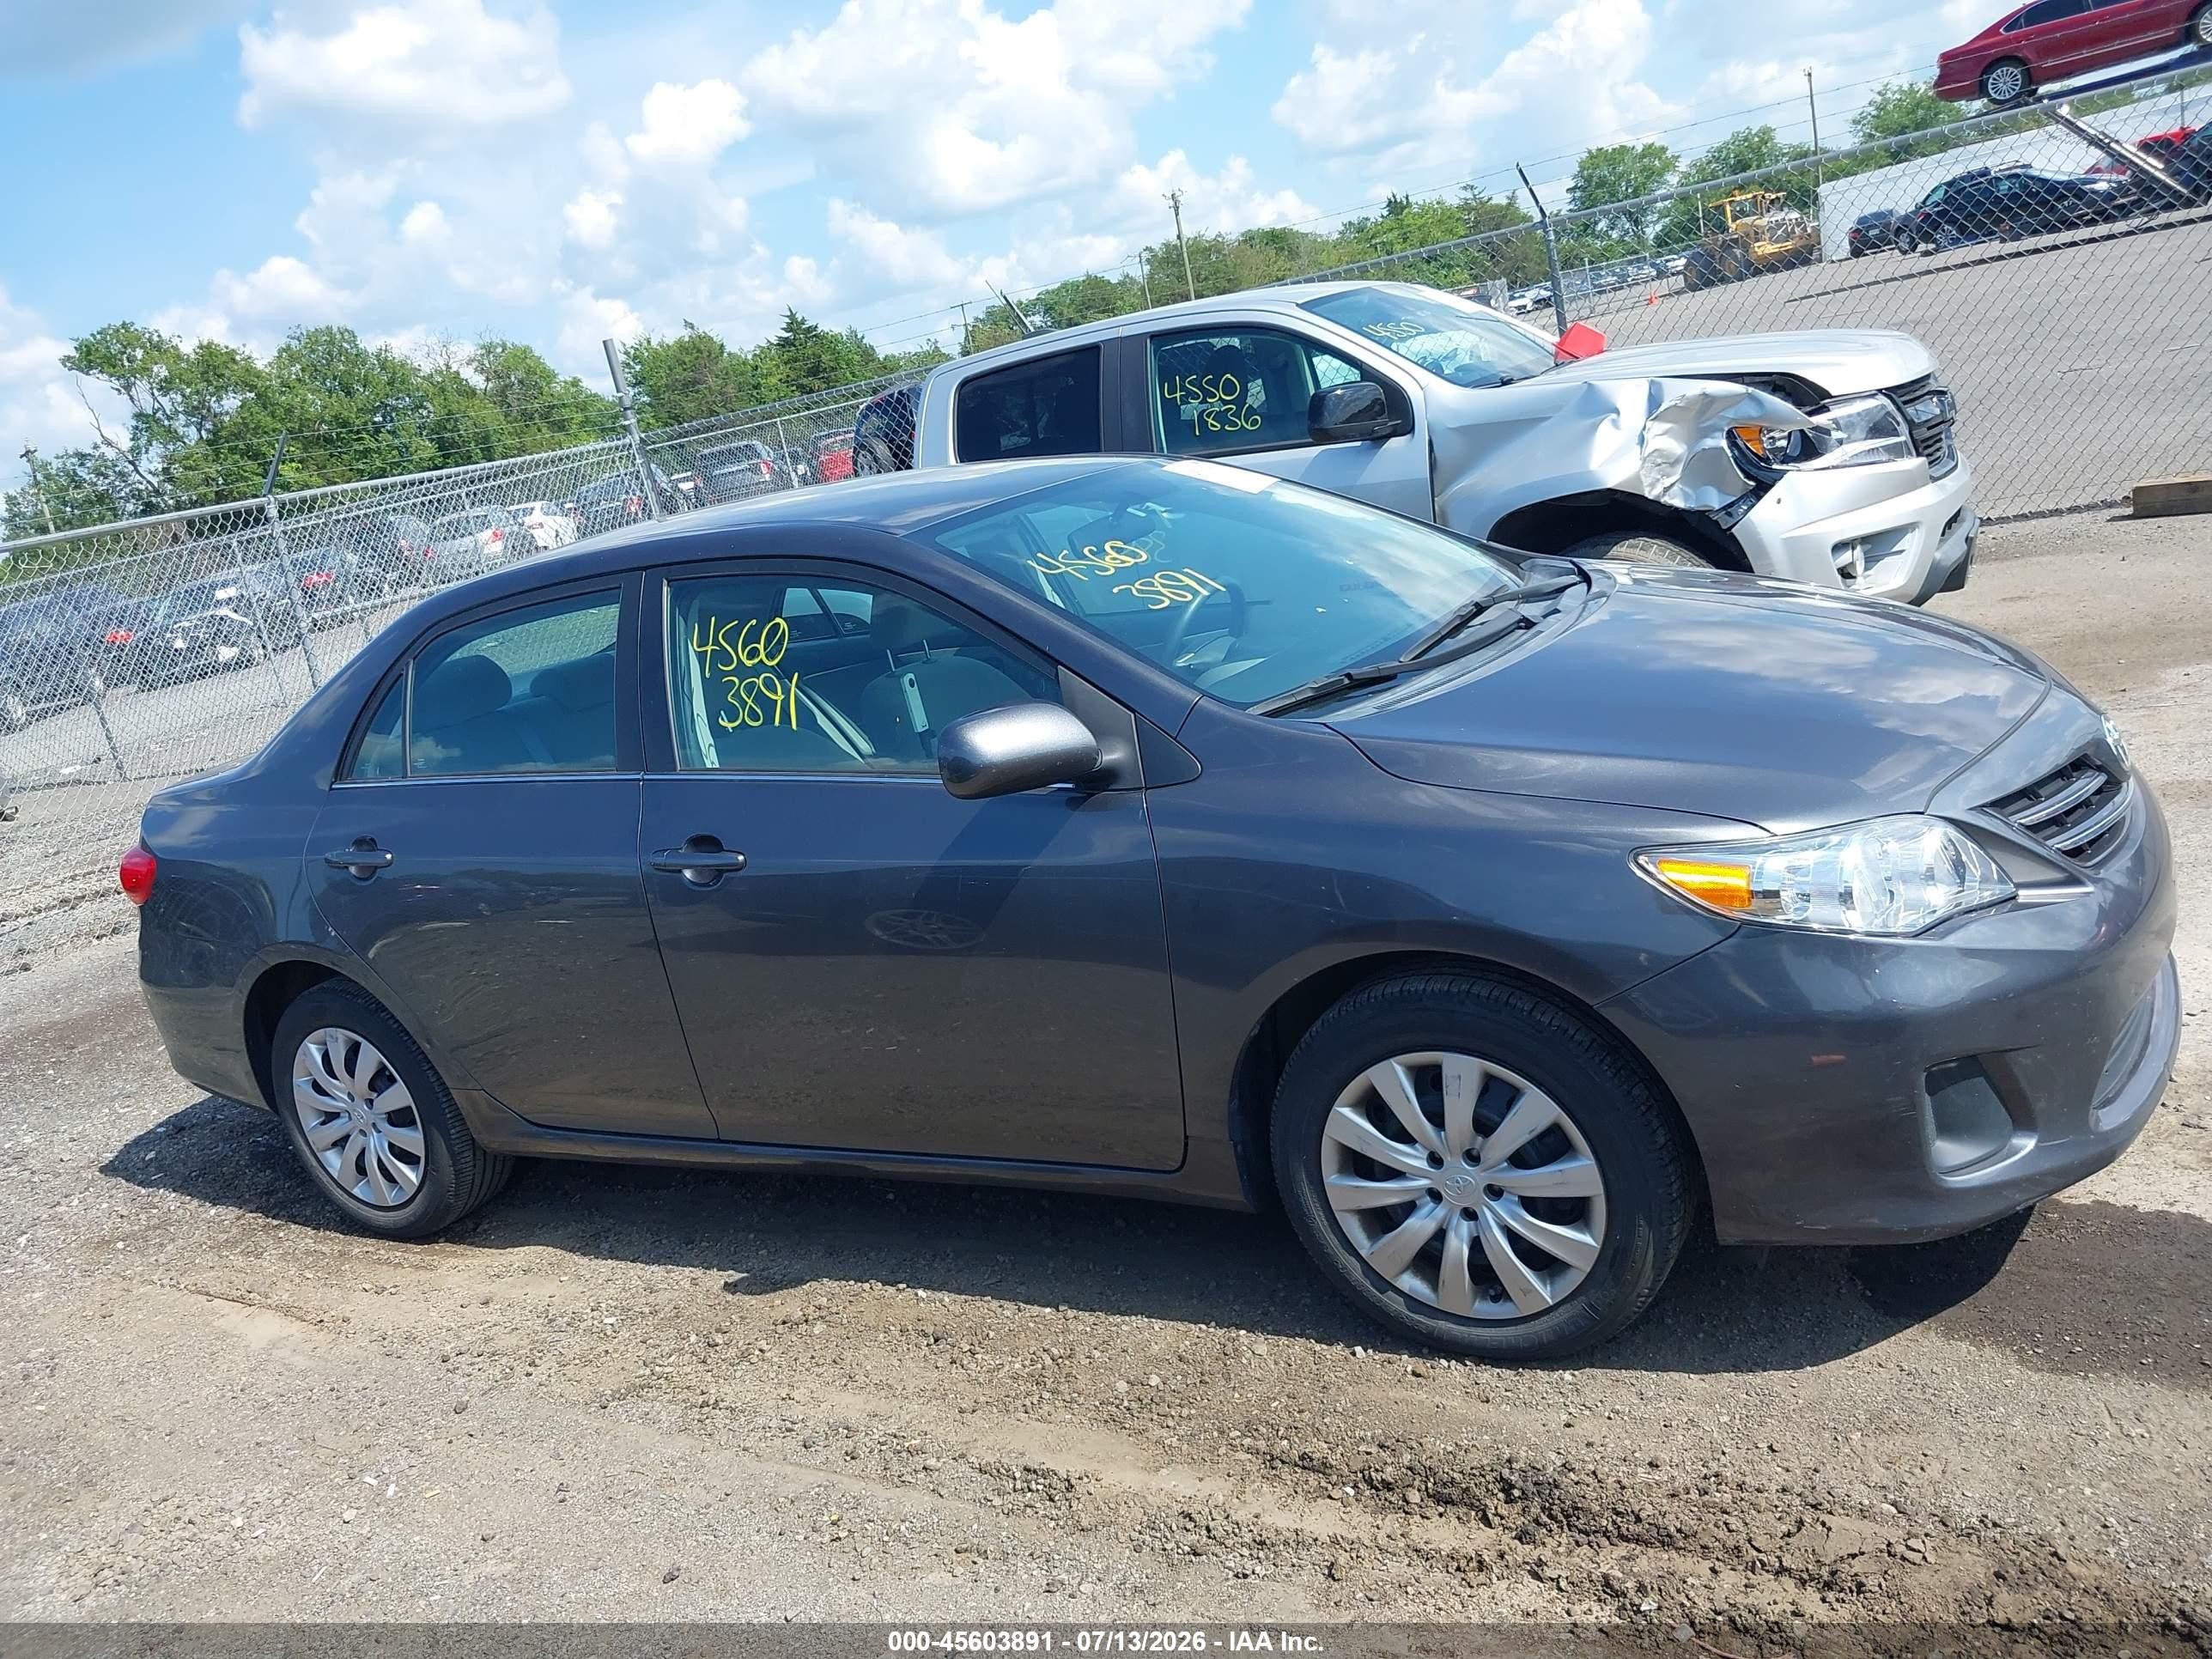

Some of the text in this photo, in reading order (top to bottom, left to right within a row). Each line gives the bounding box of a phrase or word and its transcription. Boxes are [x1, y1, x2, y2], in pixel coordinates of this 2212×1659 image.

[1361, 321, 1425, 340] 4550
[1164, 373, 1241, 406] 4550
[1193, 403, 1262, 436] 1836
[1026, 539, 1149, 581] 4560
[1112, 567, 1227, 610] 3891
[692, 614, 789, 678] 4560
[717, 671, 799, 732] 3891
